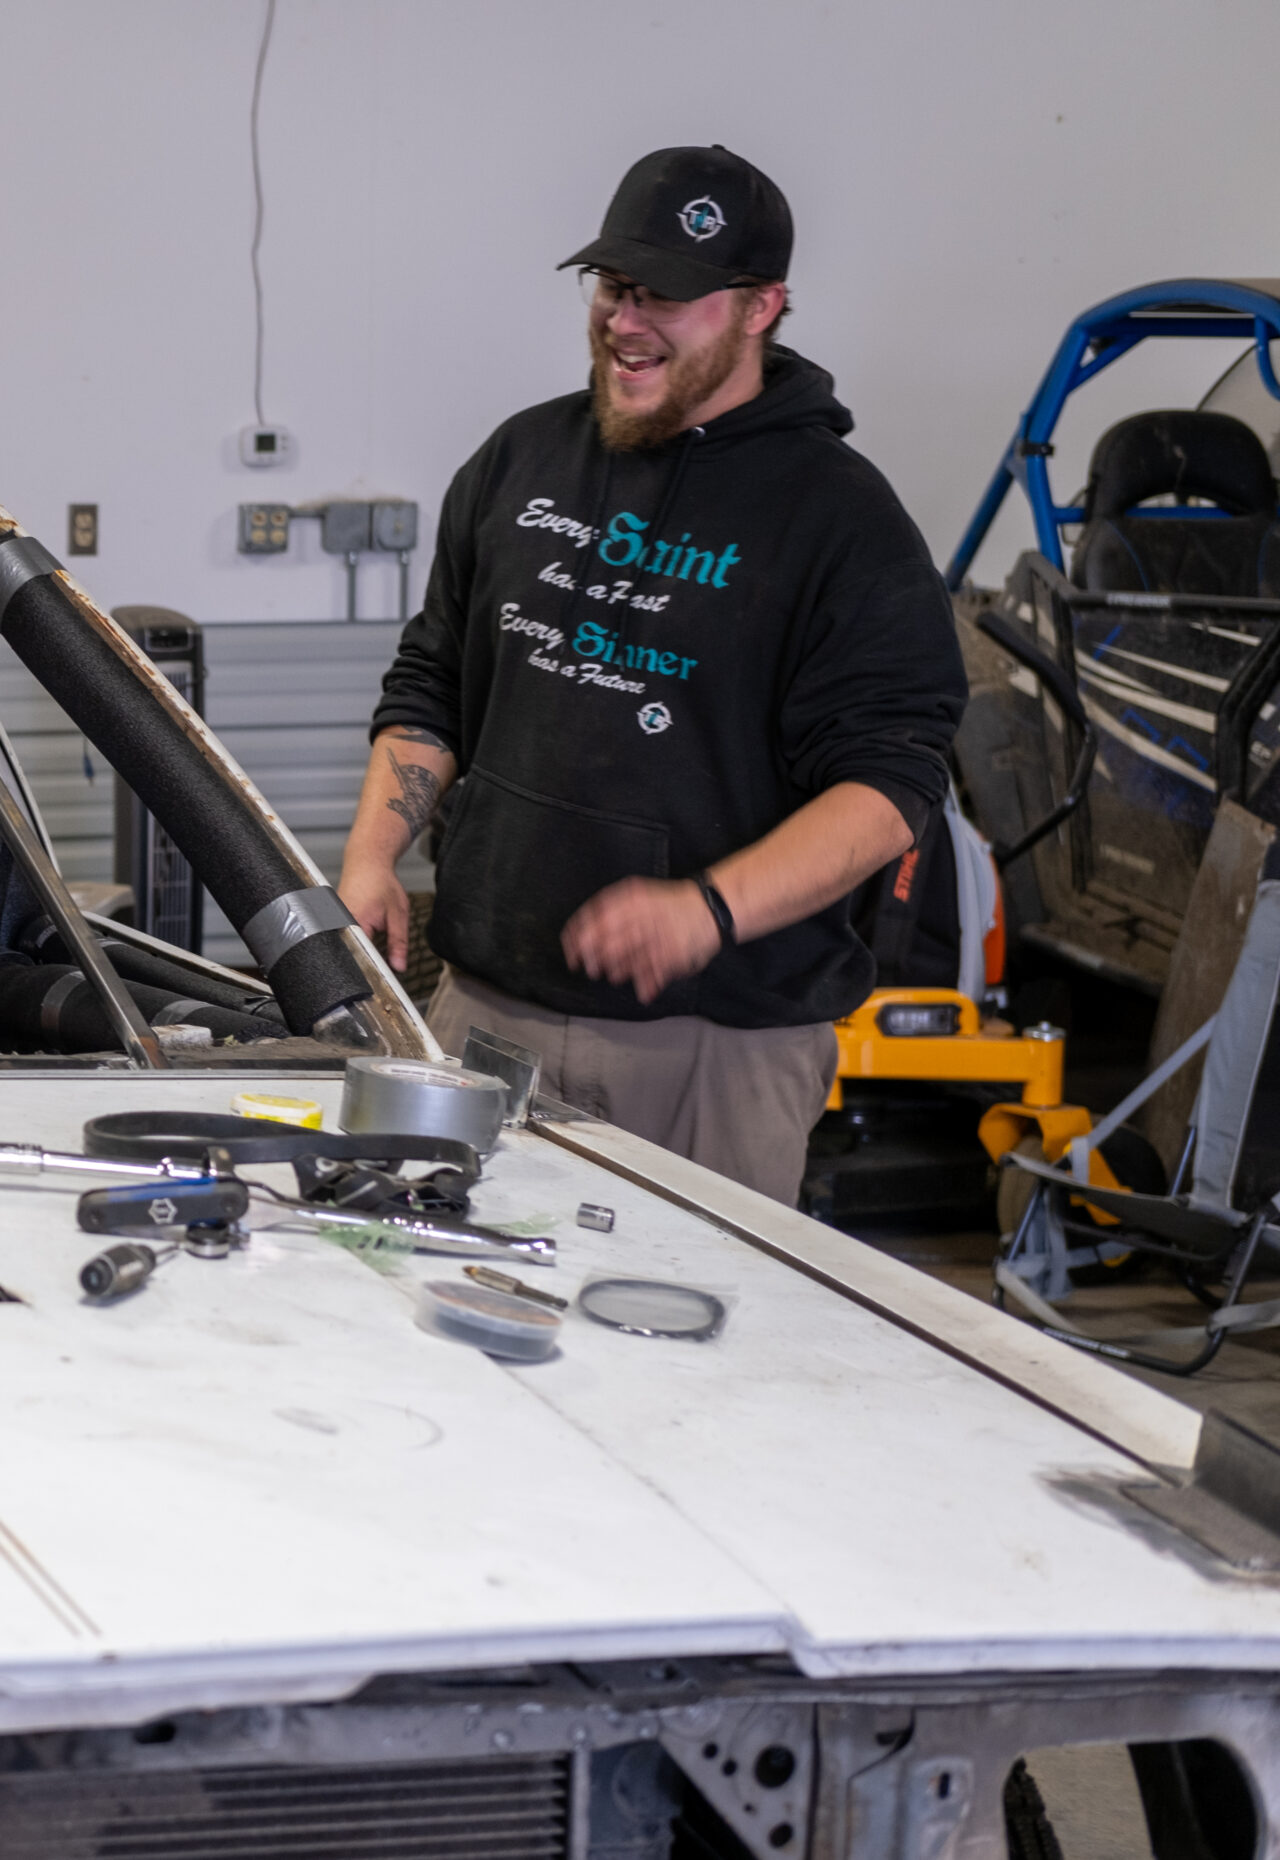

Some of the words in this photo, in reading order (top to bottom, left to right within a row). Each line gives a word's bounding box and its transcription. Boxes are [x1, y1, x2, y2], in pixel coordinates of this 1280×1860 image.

[516, 497, 600, 548] Every
[597, 511, 741, 589] Saint
[537, 561, 577, 590] has
[585, 584, 608, 600] a
[499, 602, 566, 650] Every
[572, 621, 698, 680] Sinner
[527, 648, 559, 673] has
[560, 665, 577, 678] a
[577, 663, 646, 695] Future
